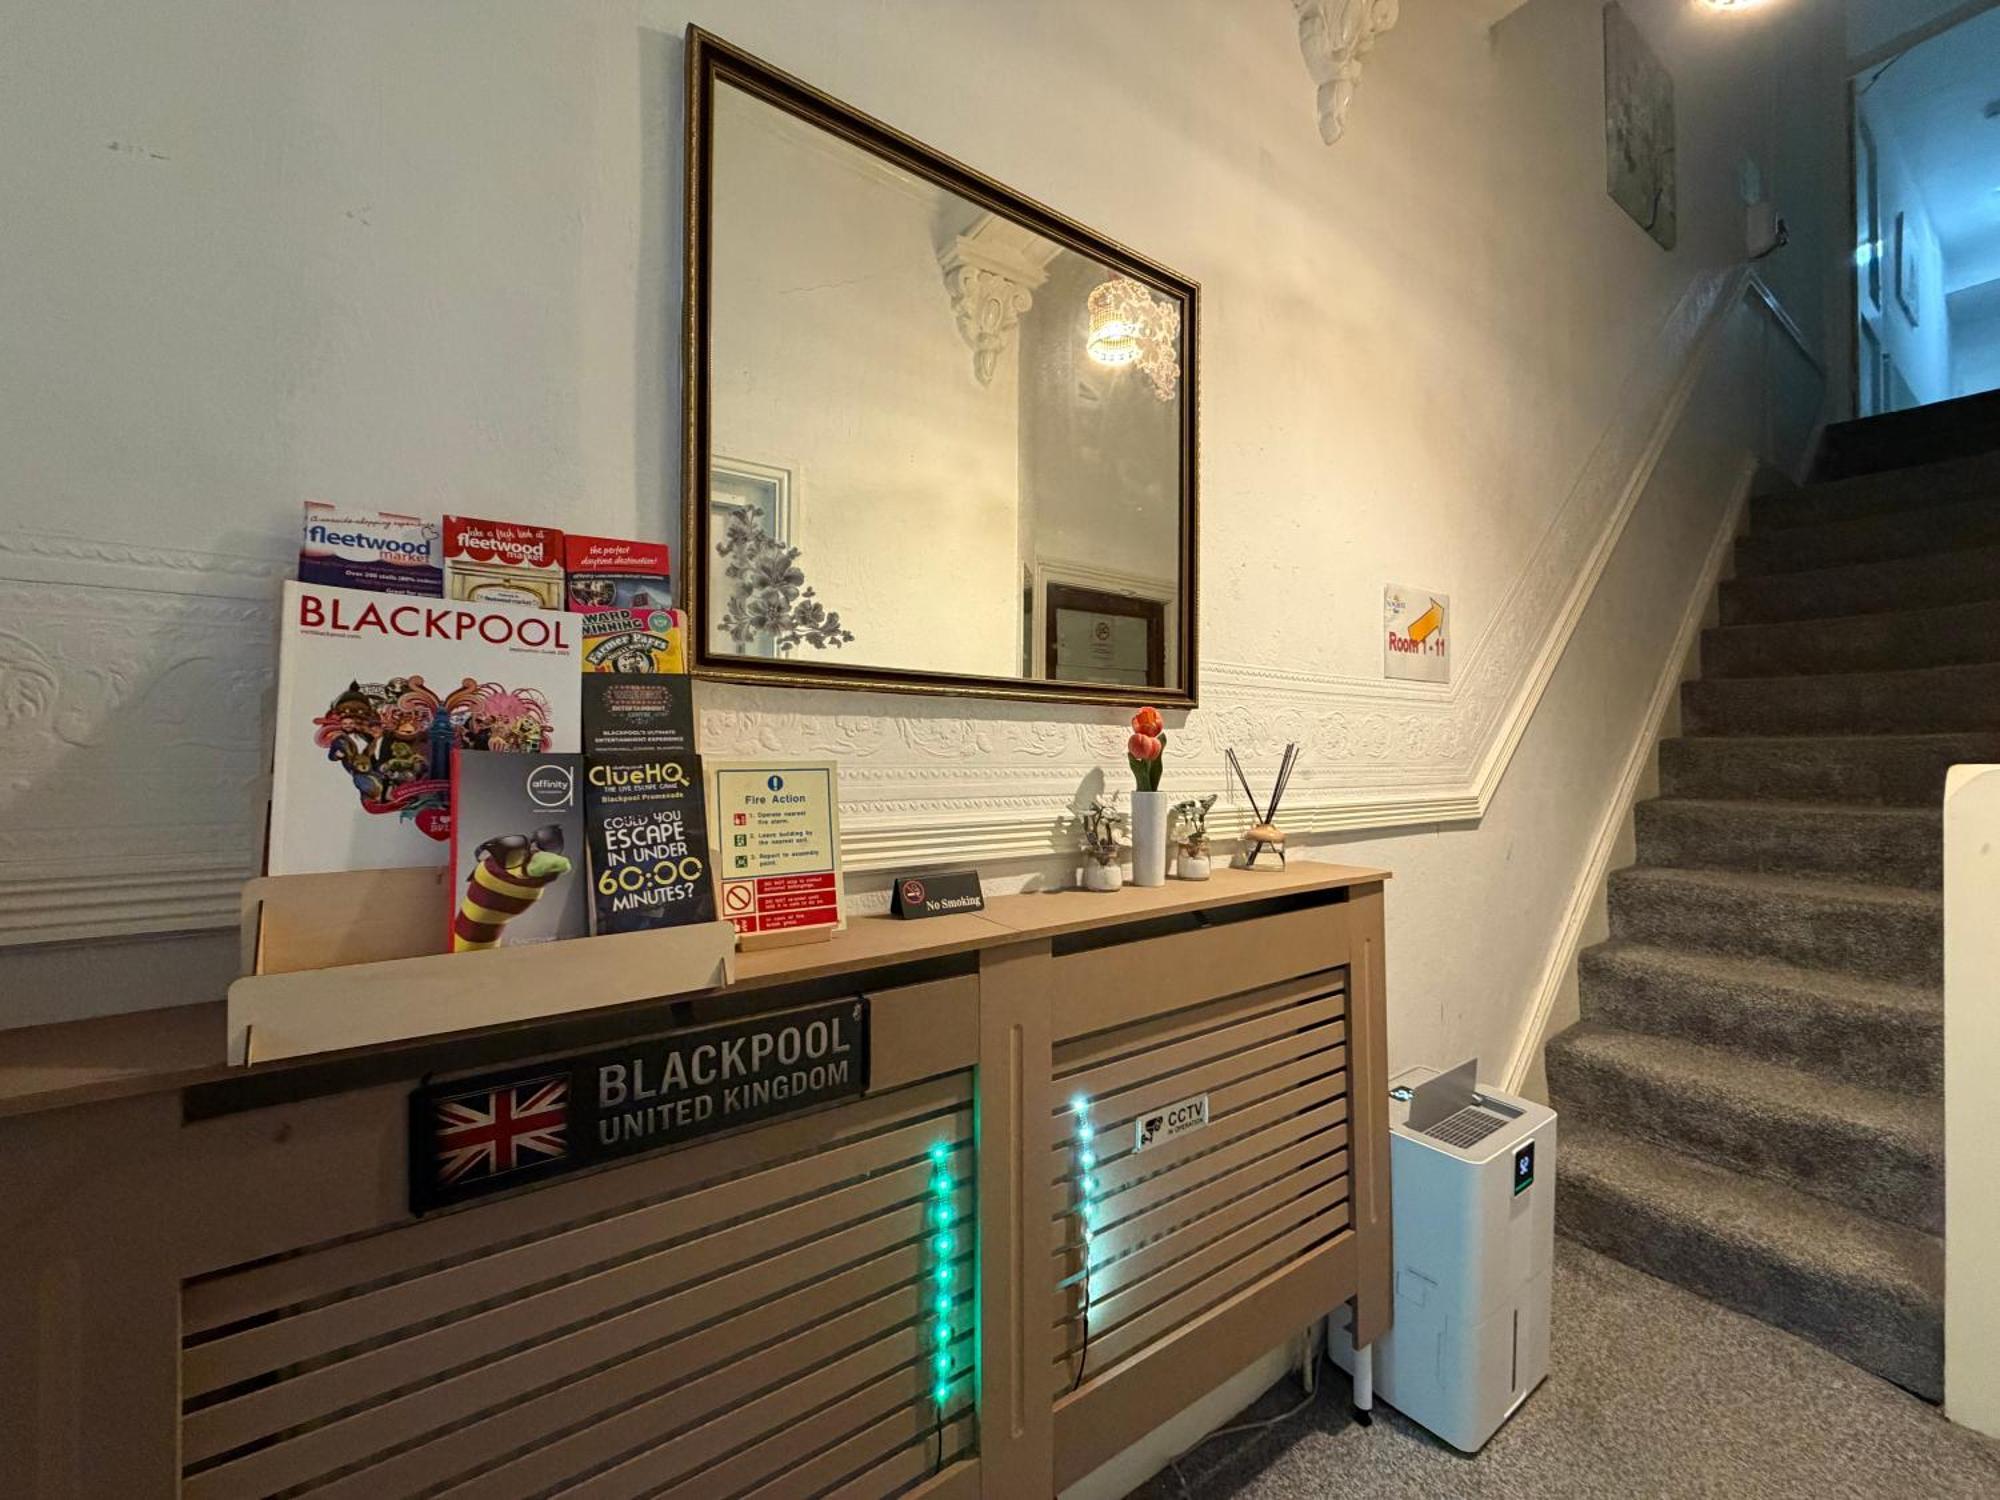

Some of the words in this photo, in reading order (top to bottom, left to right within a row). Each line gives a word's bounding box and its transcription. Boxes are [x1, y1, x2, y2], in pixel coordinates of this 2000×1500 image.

[309, 525, 431, 555] fleetwood
[457, 532, 544, 556] fleetwood
[590, 545, 603, 555] the
[604, 545, 630, 556] perfect
[381, 552, 430, 563] market
[506, 551, 544, 562] market
[300, 594, 569, 648] BLACKPOOL
[1388, 631, 1419, 654] Room
[1435, 638, 1445, 657] 11
[532, 780, 568, 790] affinity
[588, 763, 690, 787] ClueHQ
[601, 795, 641, 804] Blackpool
[642, 792, 684, 800] Promenade
[745, 795, 766, 805] Fire
[772, 795, 806, 805] Action
[604, 815, 648, 830] COULD
[605, 821, 686, 850] ESCAPE
[608, 850, 626, 867] IN
[633, 842, 688, 863] UNDER
[598, 857, 703, 896] 60:00
[612, 882, 694, 912] MINUTES?
[926, 900, 940, 912] No
[941, 895, 982, 910] Smoking
[598, 1017, 850, 1108] BLACKPOOL
[598, 1092, 713, 1145] UNITED
[723, 1060, 849, 1115] KINGDOM
[1168, 1101, 1203, 1127] CCTV
